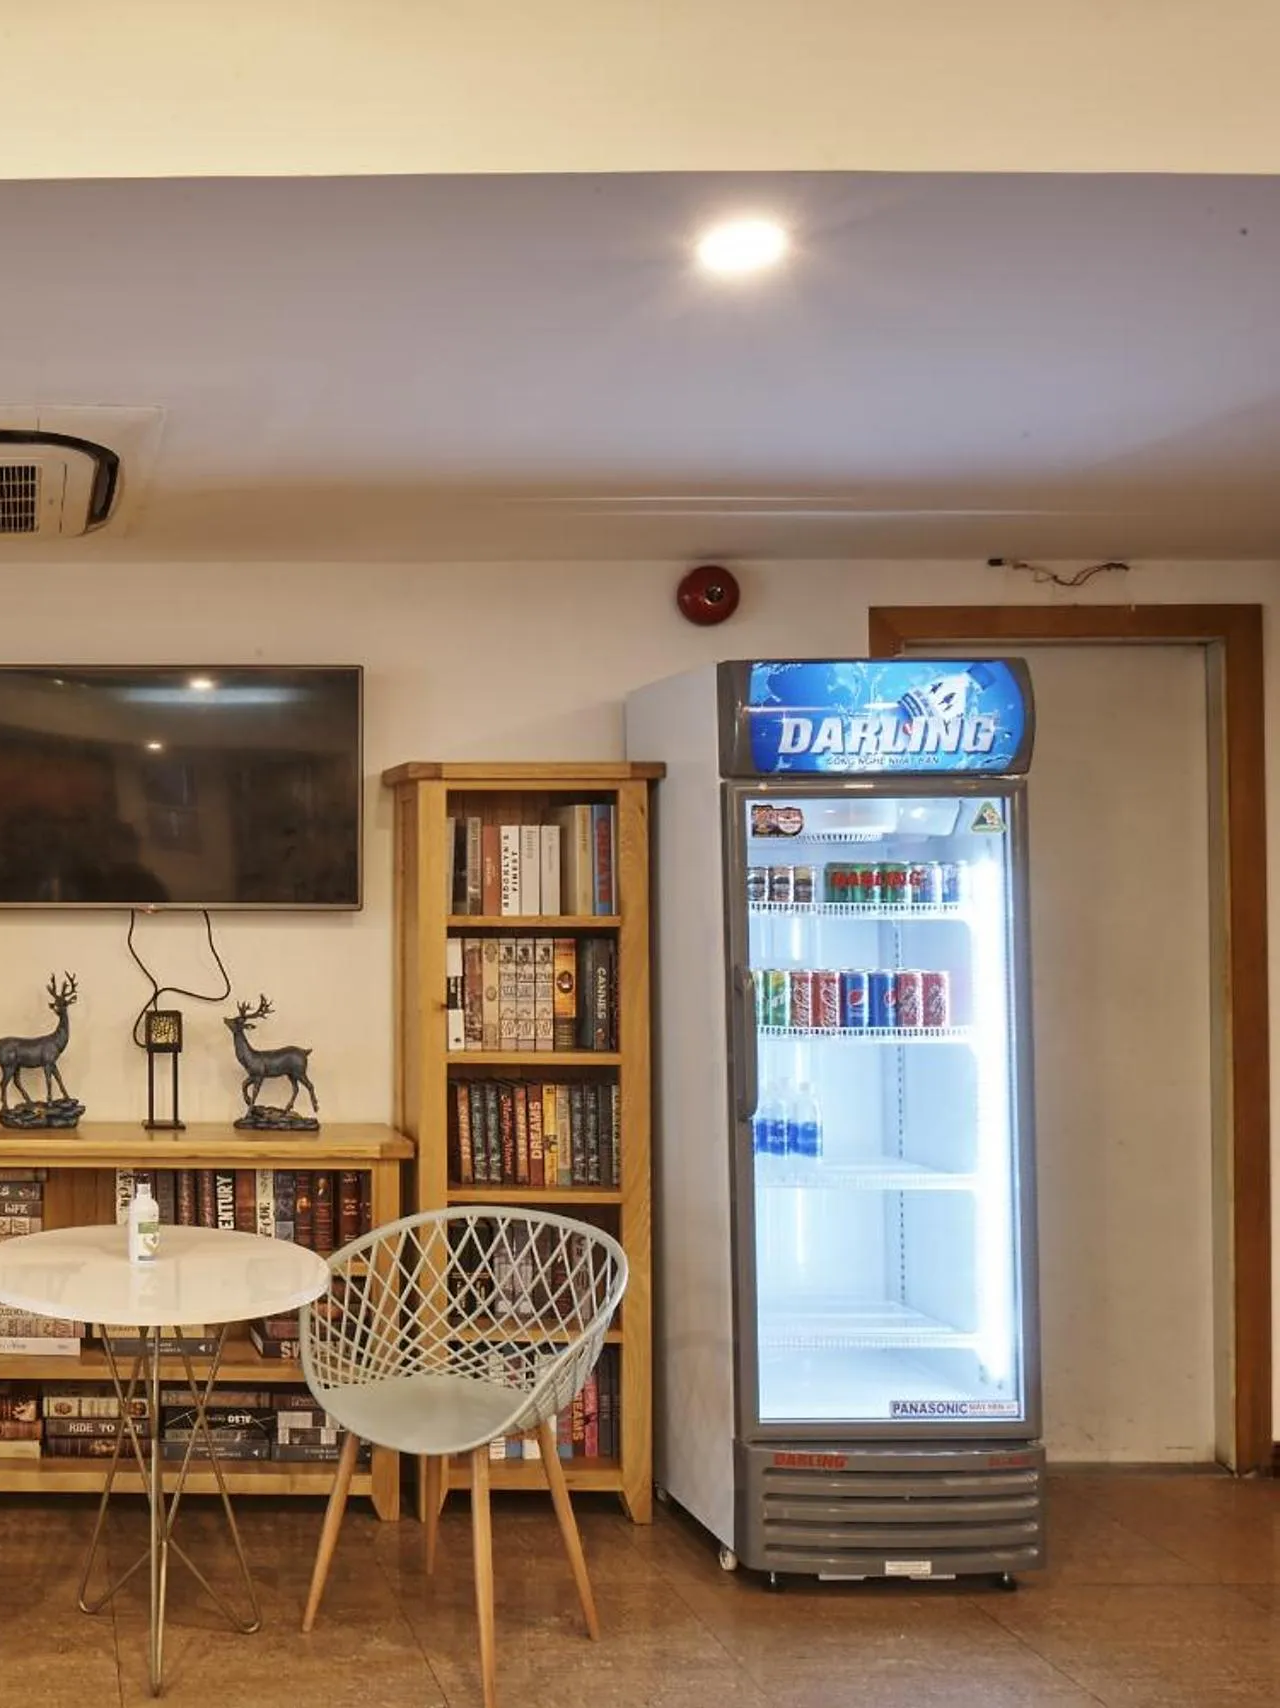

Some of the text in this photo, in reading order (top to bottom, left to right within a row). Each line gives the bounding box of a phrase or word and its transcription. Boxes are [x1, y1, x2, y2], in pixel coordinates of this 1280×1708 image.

[778, 716, 996, 754] DARLING
[595, 967, 607, 1020] CANNES
[528, 1101, 543, 1160] DREAMS
[216, 1175, 235, 1231] ENTURY
[68, 1422, 93, 1433] RIDE
[893, 1402, 968, 1414] PANASONIC
